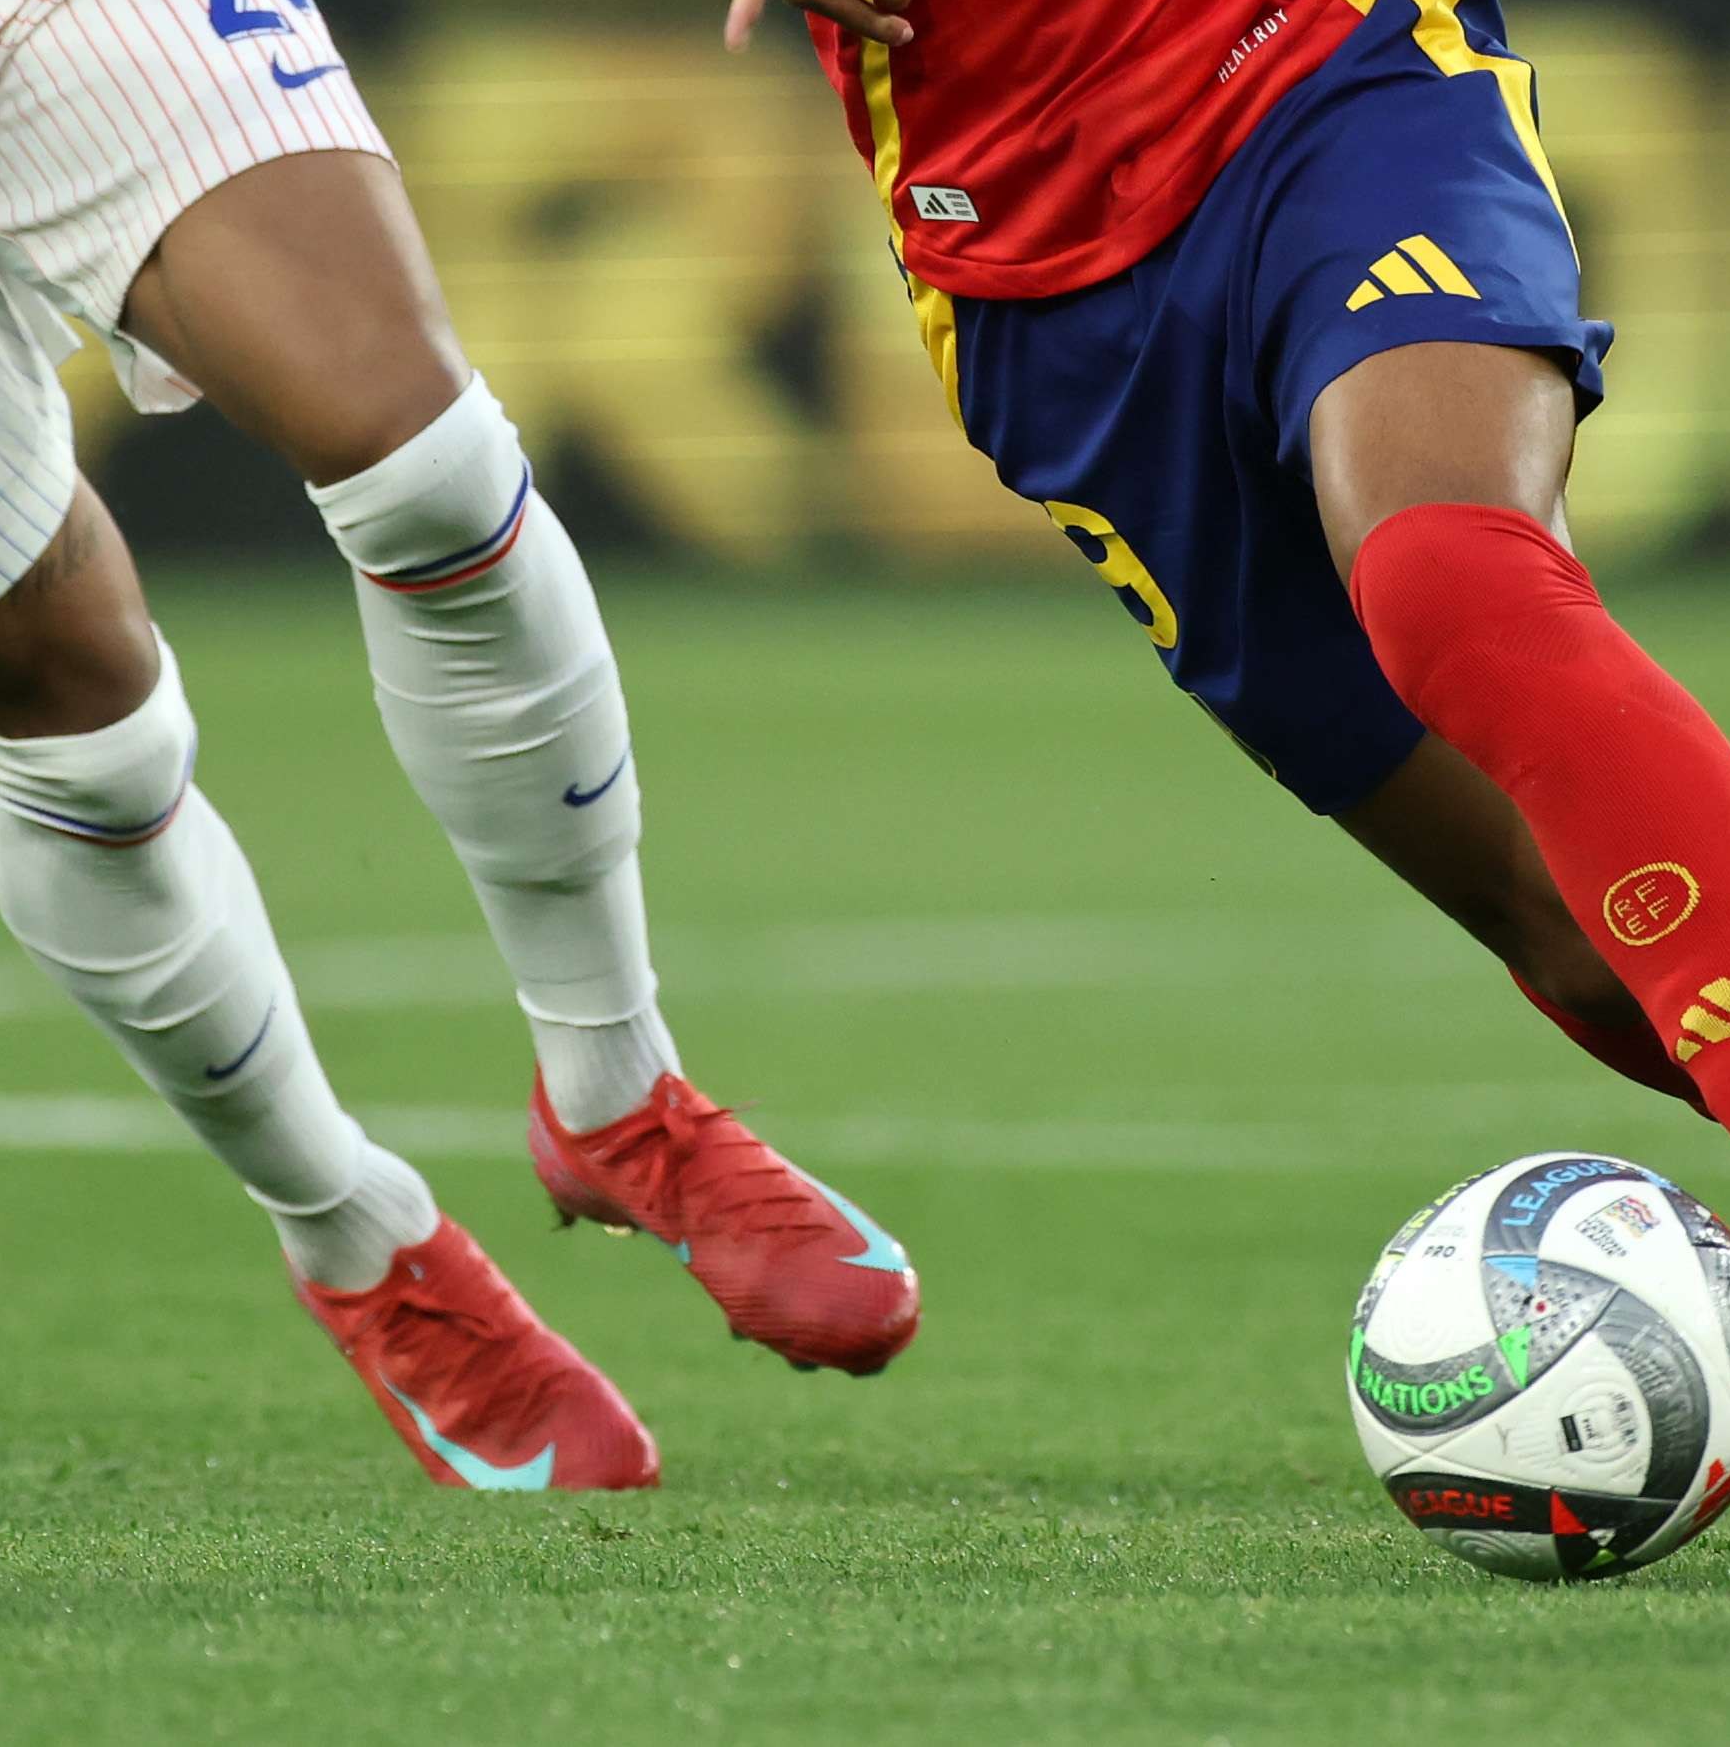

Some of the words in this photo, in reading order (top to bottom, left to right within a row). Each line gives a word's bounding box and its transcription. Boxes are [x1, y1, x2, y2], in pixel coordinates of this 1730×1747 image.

[1217, 8, 1289, 84] HEAT.RDY
[1501, 1161, 1620, 1227] LEAGUE
[1422, 1245, 1456, 1258] PRO
[1360, 1363, 1496, 1415] NATIONS
[1402, 1487, 1516, 1521] EAGUE
